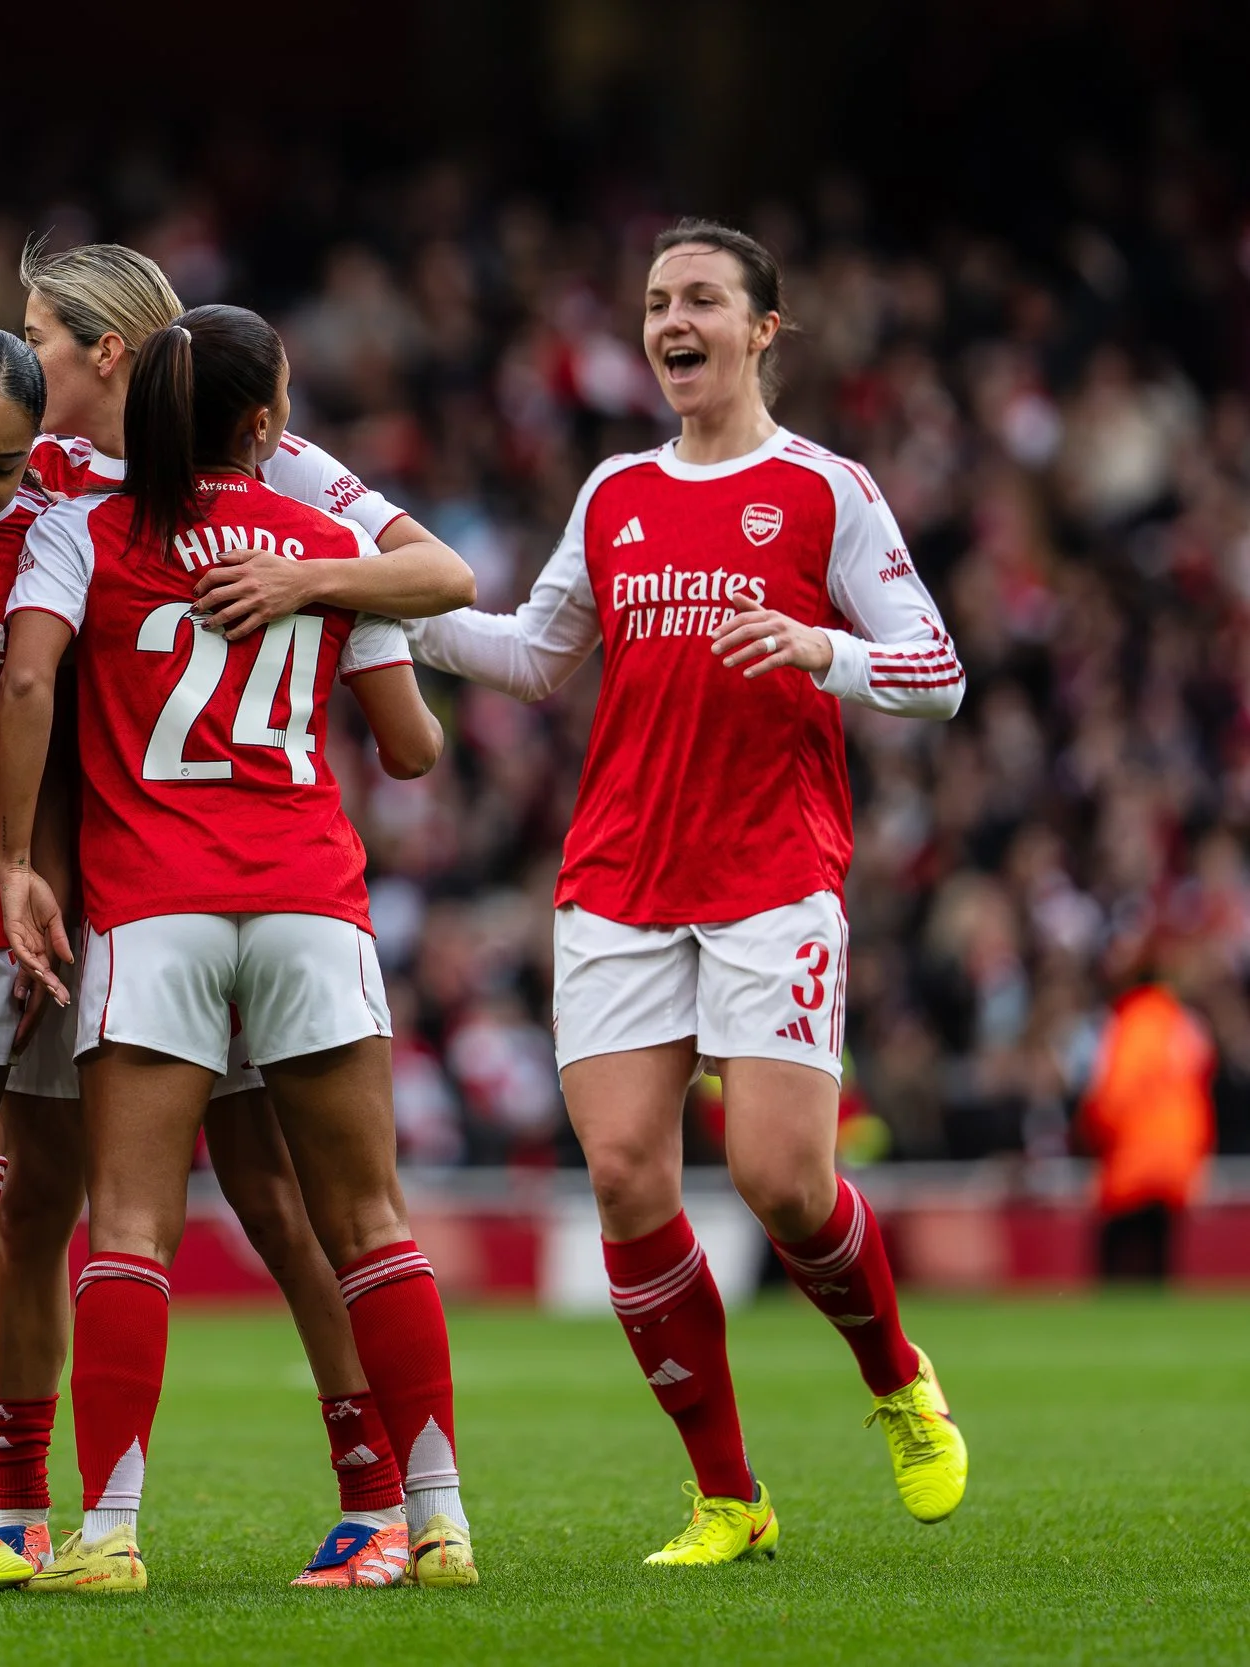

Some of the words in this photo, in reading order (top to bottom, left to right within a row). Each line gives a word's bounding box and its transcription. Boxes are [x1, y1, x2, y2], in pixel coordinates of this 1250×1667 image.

[196, 480, 248, 493] Arsenal
[329, 484, 367, 514] WAN
[613, 564, 766, 611] Emirates
[626, 608, 656, 641] FLY
[136, 602, 324, 785] 24
[791, 941, 830, 1011] 3
